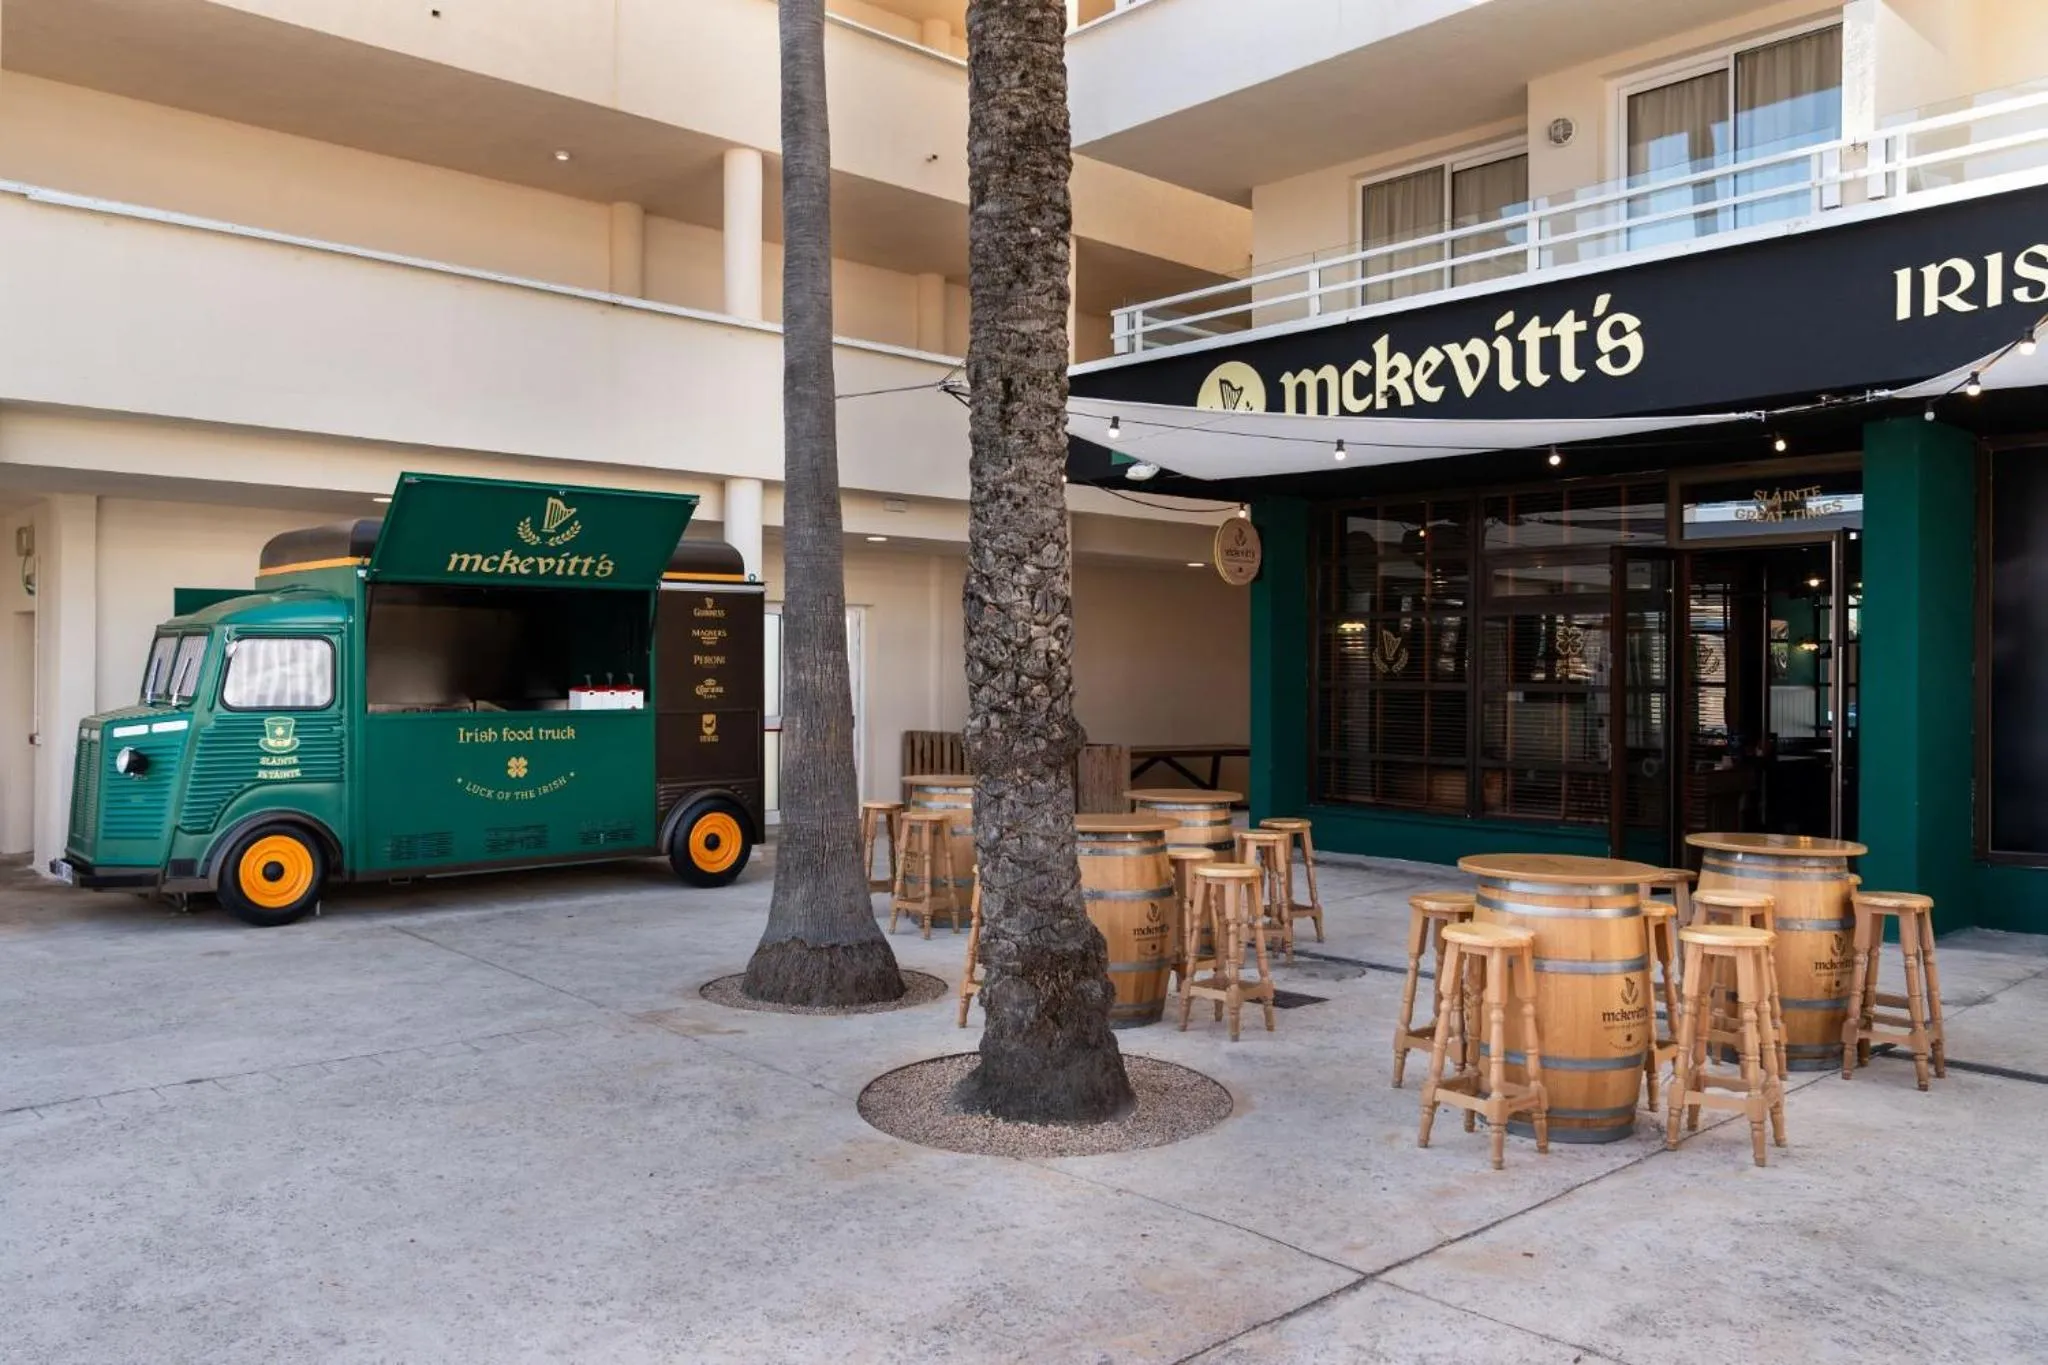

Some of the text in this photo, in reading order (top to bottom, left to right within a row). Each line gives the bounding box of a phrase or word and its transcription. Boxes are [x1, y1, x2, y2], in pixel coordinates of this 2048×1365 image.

[1893, 244, 2048, 321] IRIS
[1734, 499, 1844, 523] GREAT TIMES
[458, 725, 576, 743] Irish food truck
[465, 775, 567, 801] LUCK OF THE IRISH
